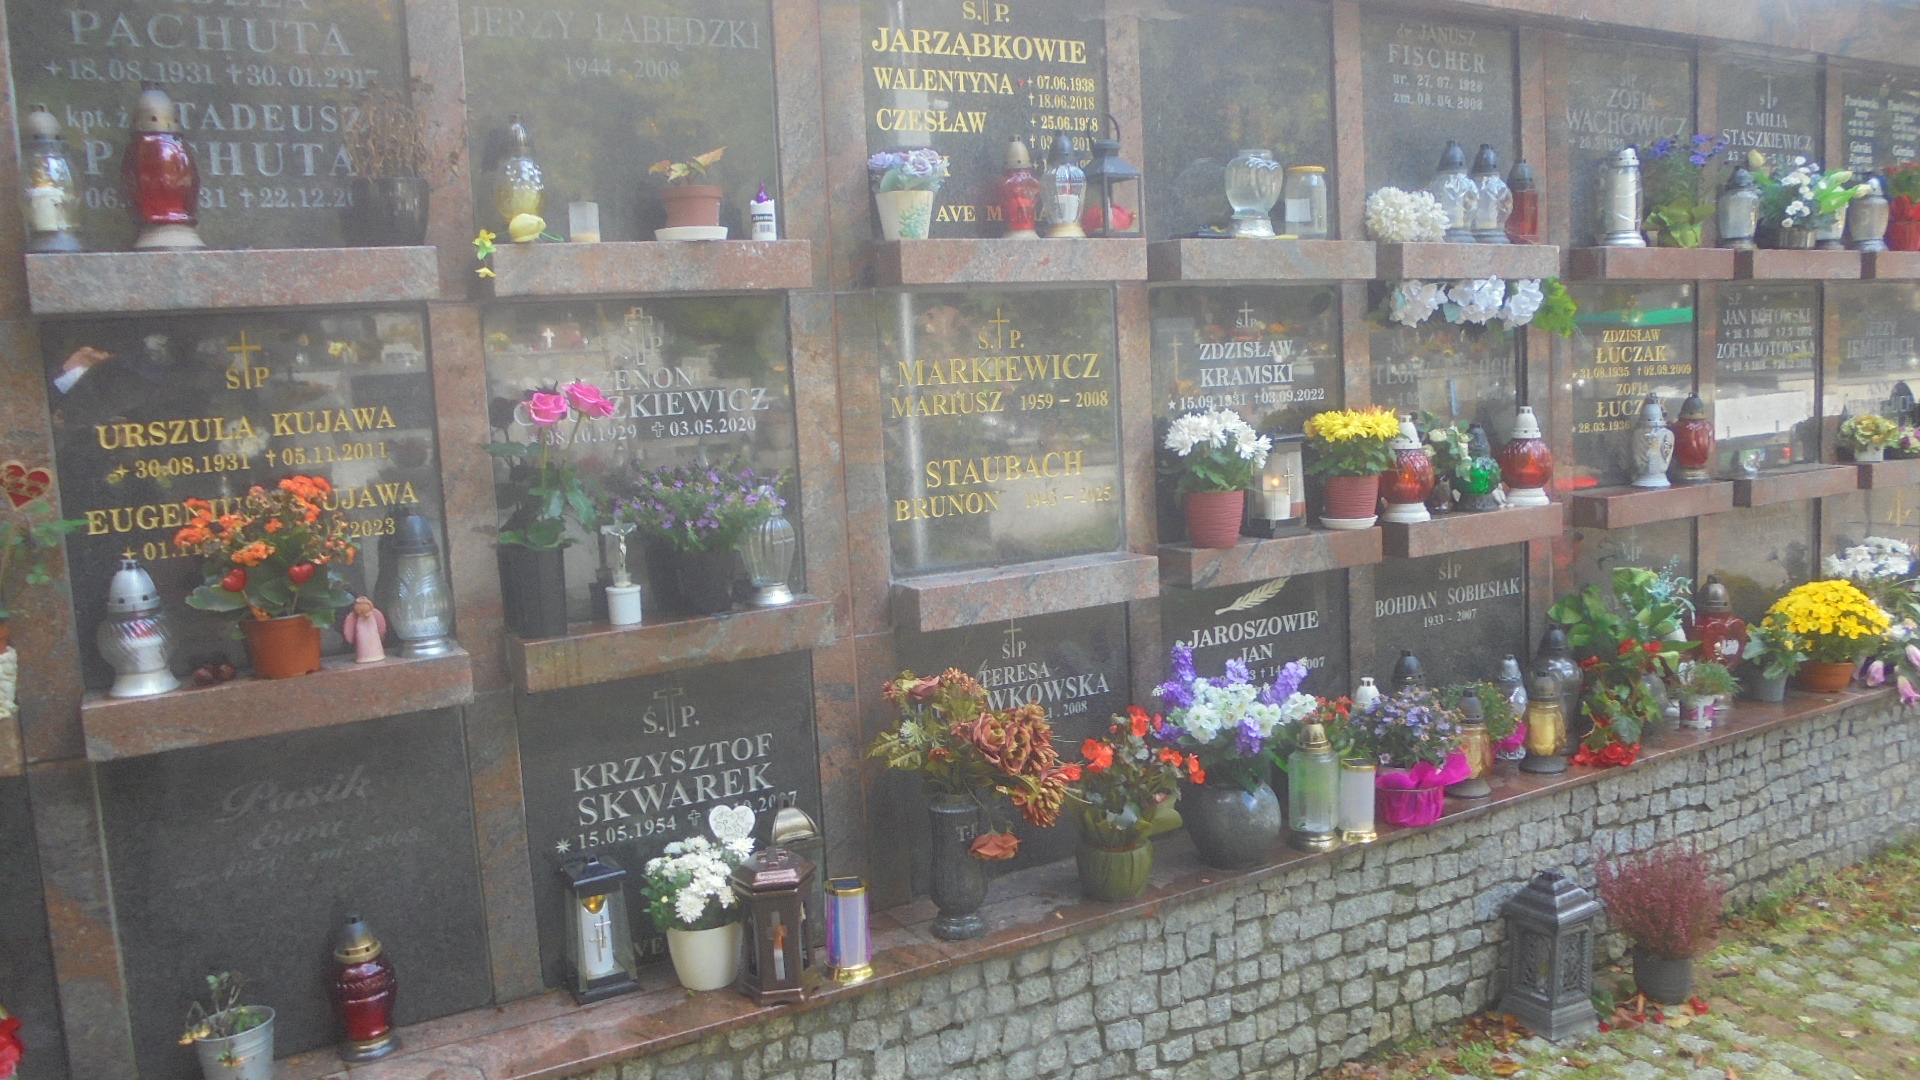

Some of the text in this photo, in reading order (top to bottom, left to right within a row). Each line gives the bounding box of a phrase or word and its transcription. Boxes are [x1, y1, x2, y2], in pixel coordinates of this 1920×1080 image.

[70, 10, 354, 57] PACHUTA
[469, 5, 574, 40] JERZY
[871, 27, 1087, 65] JARZĄBKOWIE
[1388, 42, 1486, 74] FISCHER
[634, 59, 681, 79] 2008
[872, 66, 1095, 95] WALENTYNA 07.06.1938
[1038, 94, 1095, 111] 18.06.2018
[1606, 87, 1656, 112] ZOFIA
[876, 107, 987, 133] CZESŁAW
[1566, 106, 1689, 139] WACHOWICZ
[1746, 110, 1789, 128] EMILIA
[1722, 128, 1812, 150] STASZKIEWICZ
[84, 140, 357, 178] PHUTA
[935, 205, 977, 222] AVE
[1010, 329, 1025, 349] P.
[1603, 328, 1662, 343] ZDZISŁAW
[1199, 339, 1294, 361] ZDZISŁAW
[1595, 344, 1668, 364] ŁUCZAK
[1716, 342, 1751, 359] ZOFIA
[254, 366, 270, 388] P
[898, 353, 1101, 387] MARKIEWICZ
[1199, 364, 1295, 388] KRAMSKI
[1180, 388, 1325, 411] 15.09.1931 03.09.2022
[1616, 381, 1650, 396] ZOFIA
[890, 391, 1005, 419] MARIUSZ
[1020, 393, 1054, 411] 1959
[1075, 390, 1109, 408] 2008
[1596, 399, 1662, 418] ŁUCZ
[96, 405, 397, 451] URSZULA KUJAWA
[669, 416, 757, 438] 03.05.2020
[134, 441, 389, 480] 30.08.1931 05.11.2011
[926, 450, 1085, 489] STAUBACH
[306, 481, 420, 513] UJAWA
[895, 490, 1000, 522] BRUNON
[1375, 577, 1521, 619] BOHDAN SOBIESIAK
[1187, 610, 1320, 650] JAROSZOWIE
[1423, 614, 1446, 629] 1933
[1456, 608, 1478, 623] 2007
[1240, 643, 1274, 664] JAN
[979, 661, 1051, 688] TERESA
[643, 704, 700, 735] Ś. P.
[572, 732, 774, 793] KRZYSZTOF
[577, 761, 775, 827] SKWAREK
[578, 815, 678, 850] 15.05.1954
